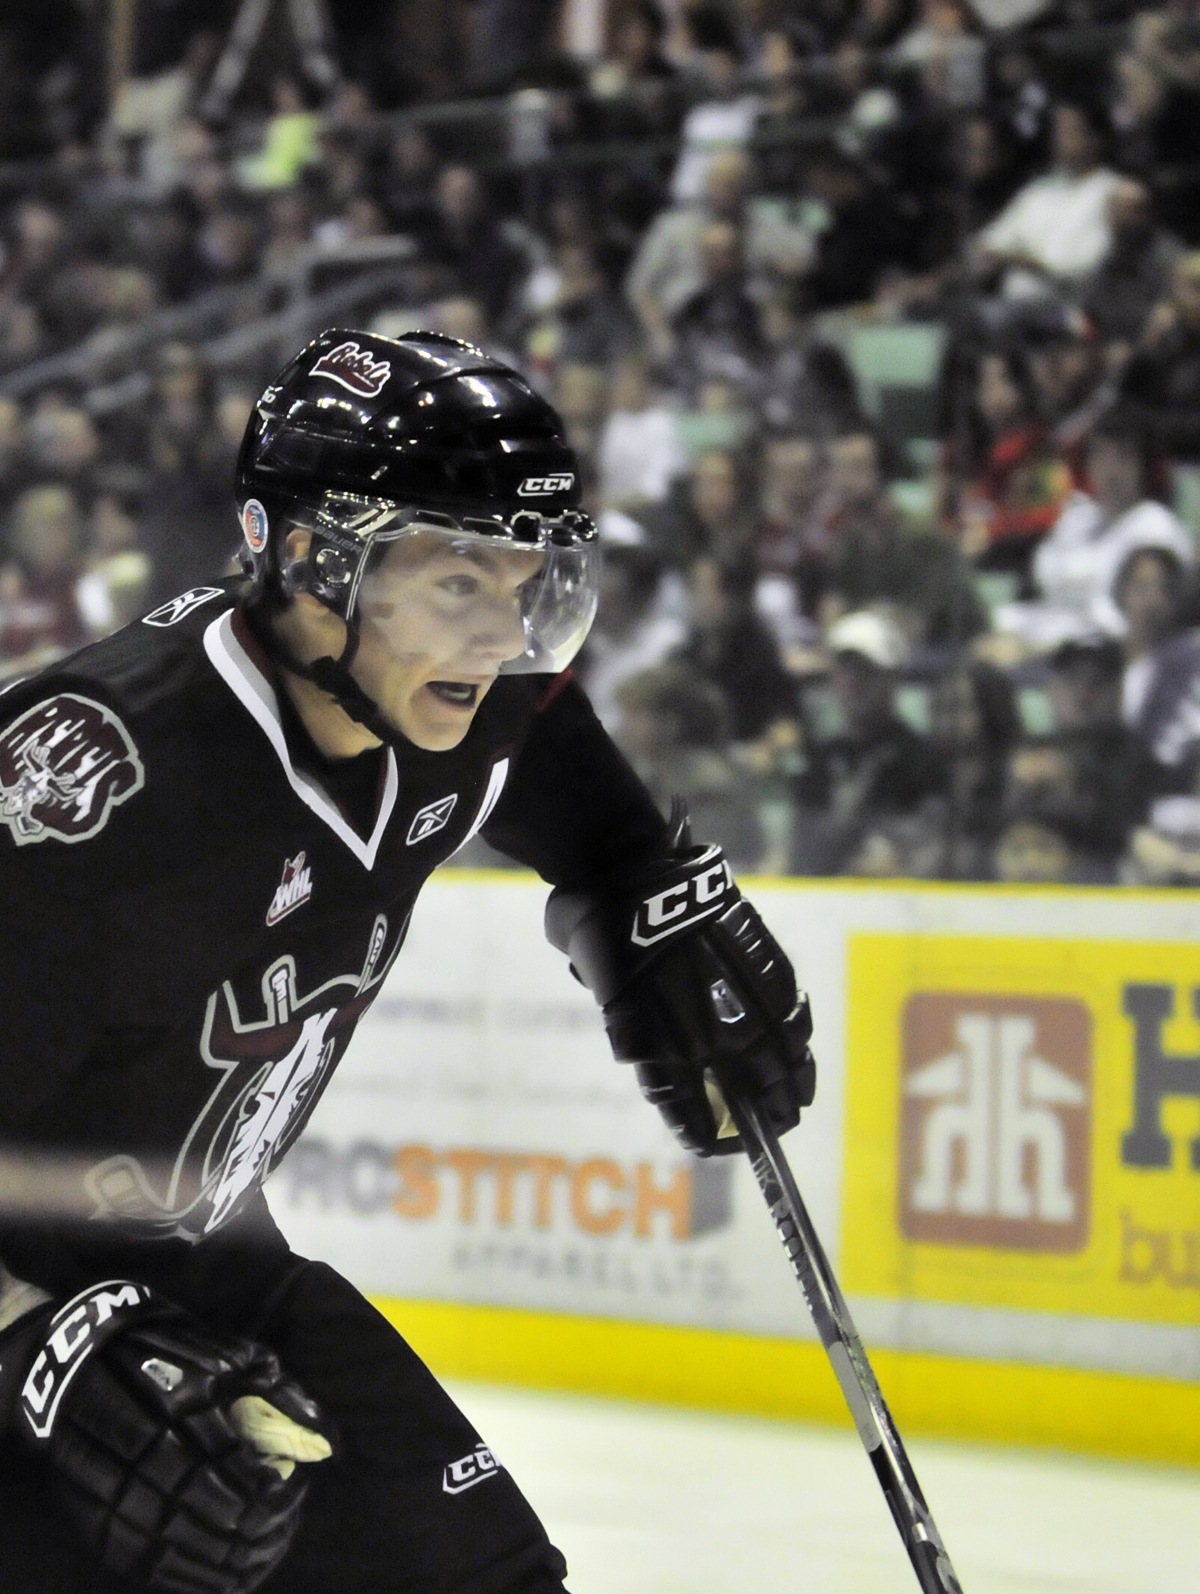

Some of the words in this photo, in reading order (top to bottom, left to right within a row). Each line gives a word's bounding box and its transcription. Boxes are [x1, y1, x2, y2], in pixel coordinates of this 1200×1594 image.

[525, 478, 572, 491] CCM
[22, 1286, 141, 1414] CCM
[448, 1449, 501, 1482] CC
